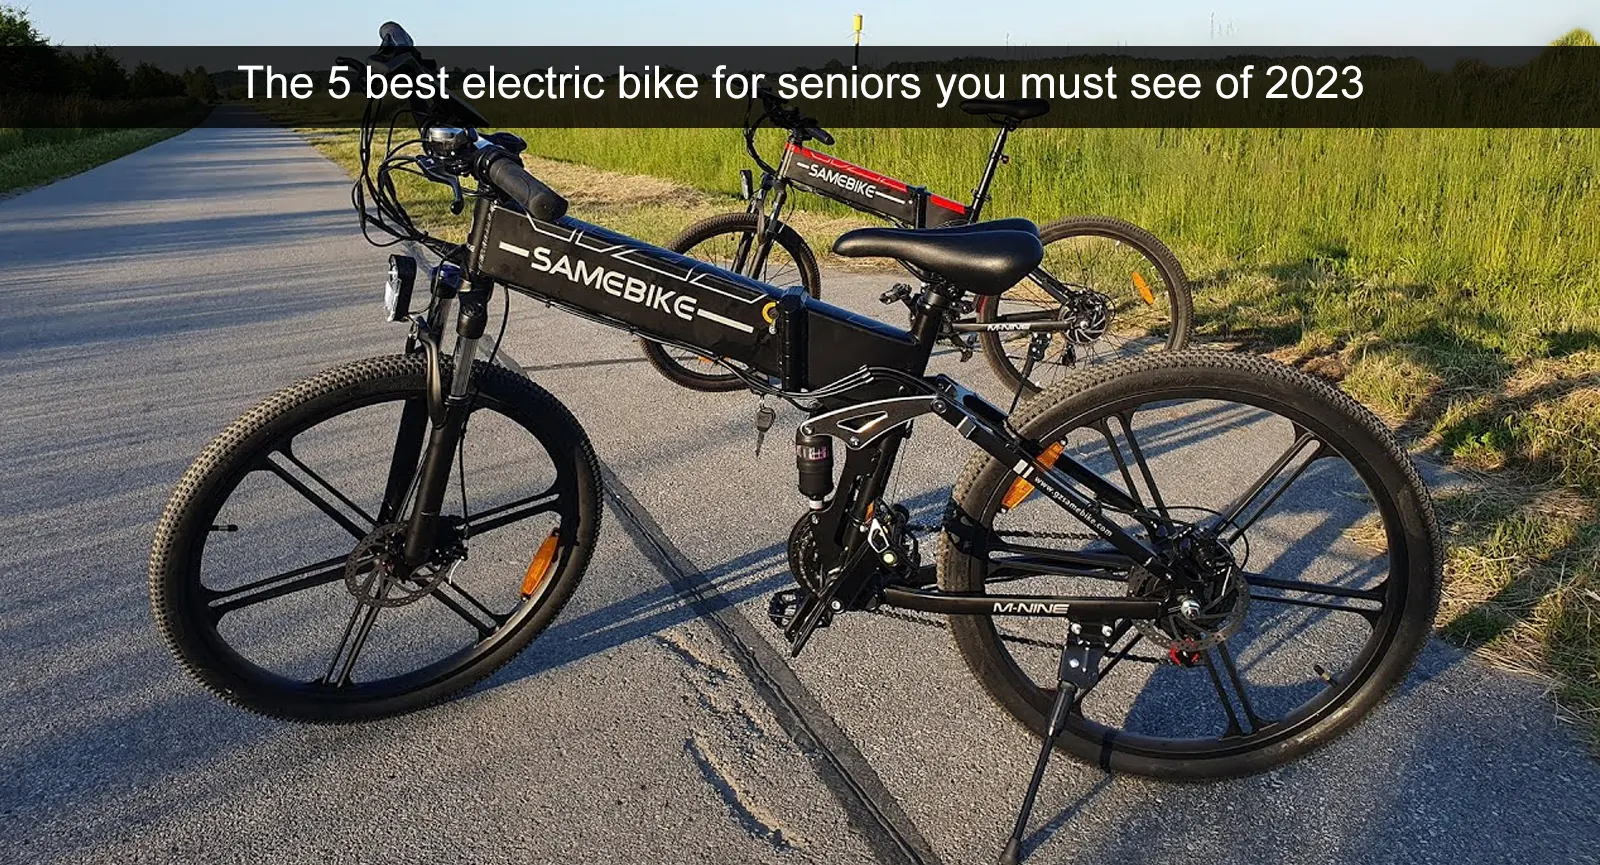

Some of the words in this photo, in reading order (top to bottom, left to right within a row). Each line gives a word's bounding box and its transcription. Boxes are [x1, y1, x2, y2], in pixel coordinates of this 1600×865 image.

[808, 163, 877, 199] SAMEBIKE
[531, 246, 698, 321] SAMEBIKE
[1034, 476, 1113, 537] www.gzsamebike.com
[993, 602, 1070, 614] M-NINE
